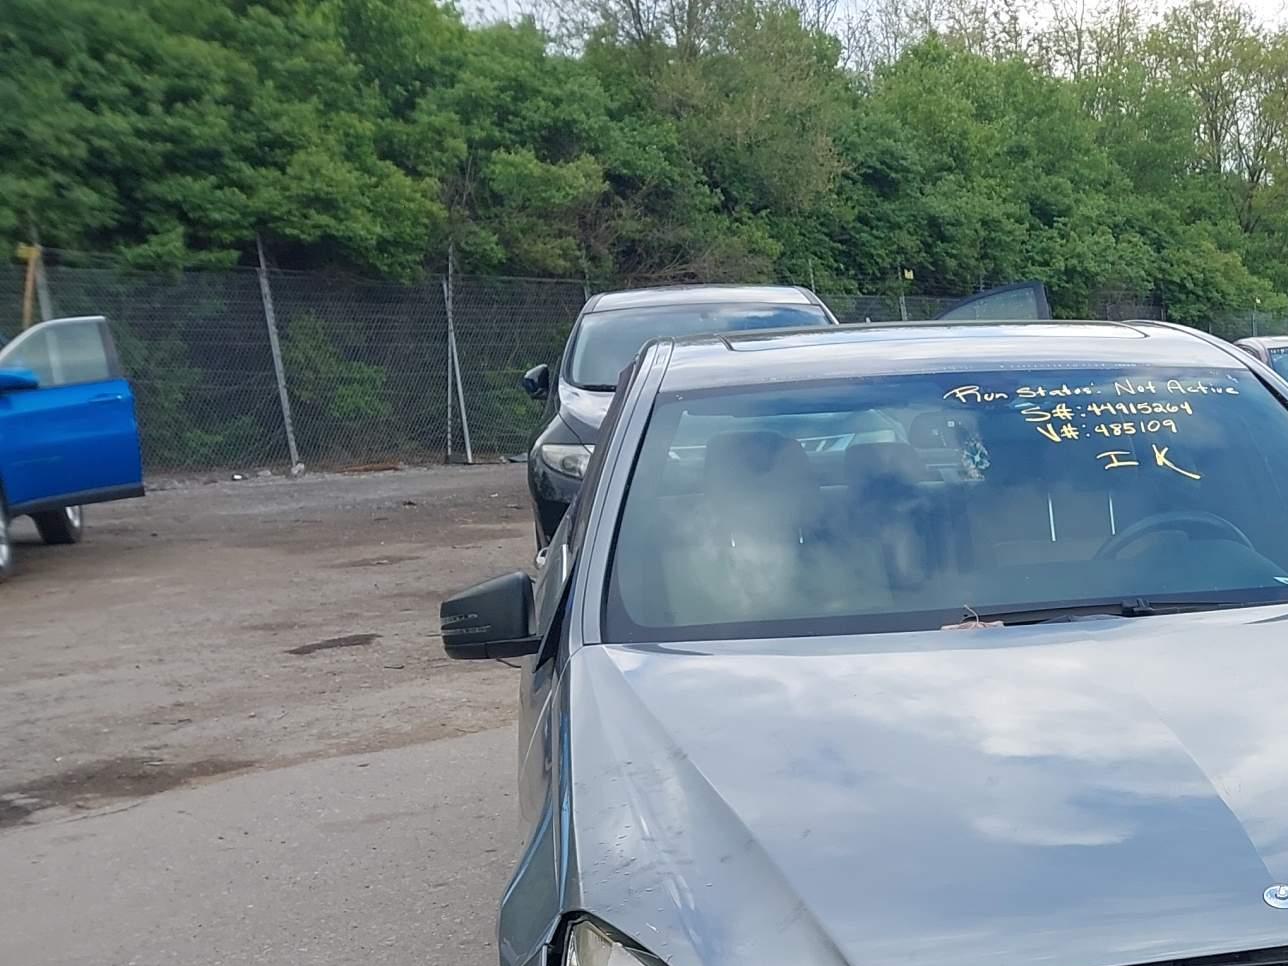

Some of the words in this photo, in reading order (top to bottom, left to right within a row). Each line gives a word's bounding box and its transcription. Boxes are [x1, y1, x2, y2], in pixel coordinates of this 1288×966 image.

[943, 385, 1009, 403] Run
[1114, 379, 1157, 396] Not
[1167, 379, 1240, 395] Active
